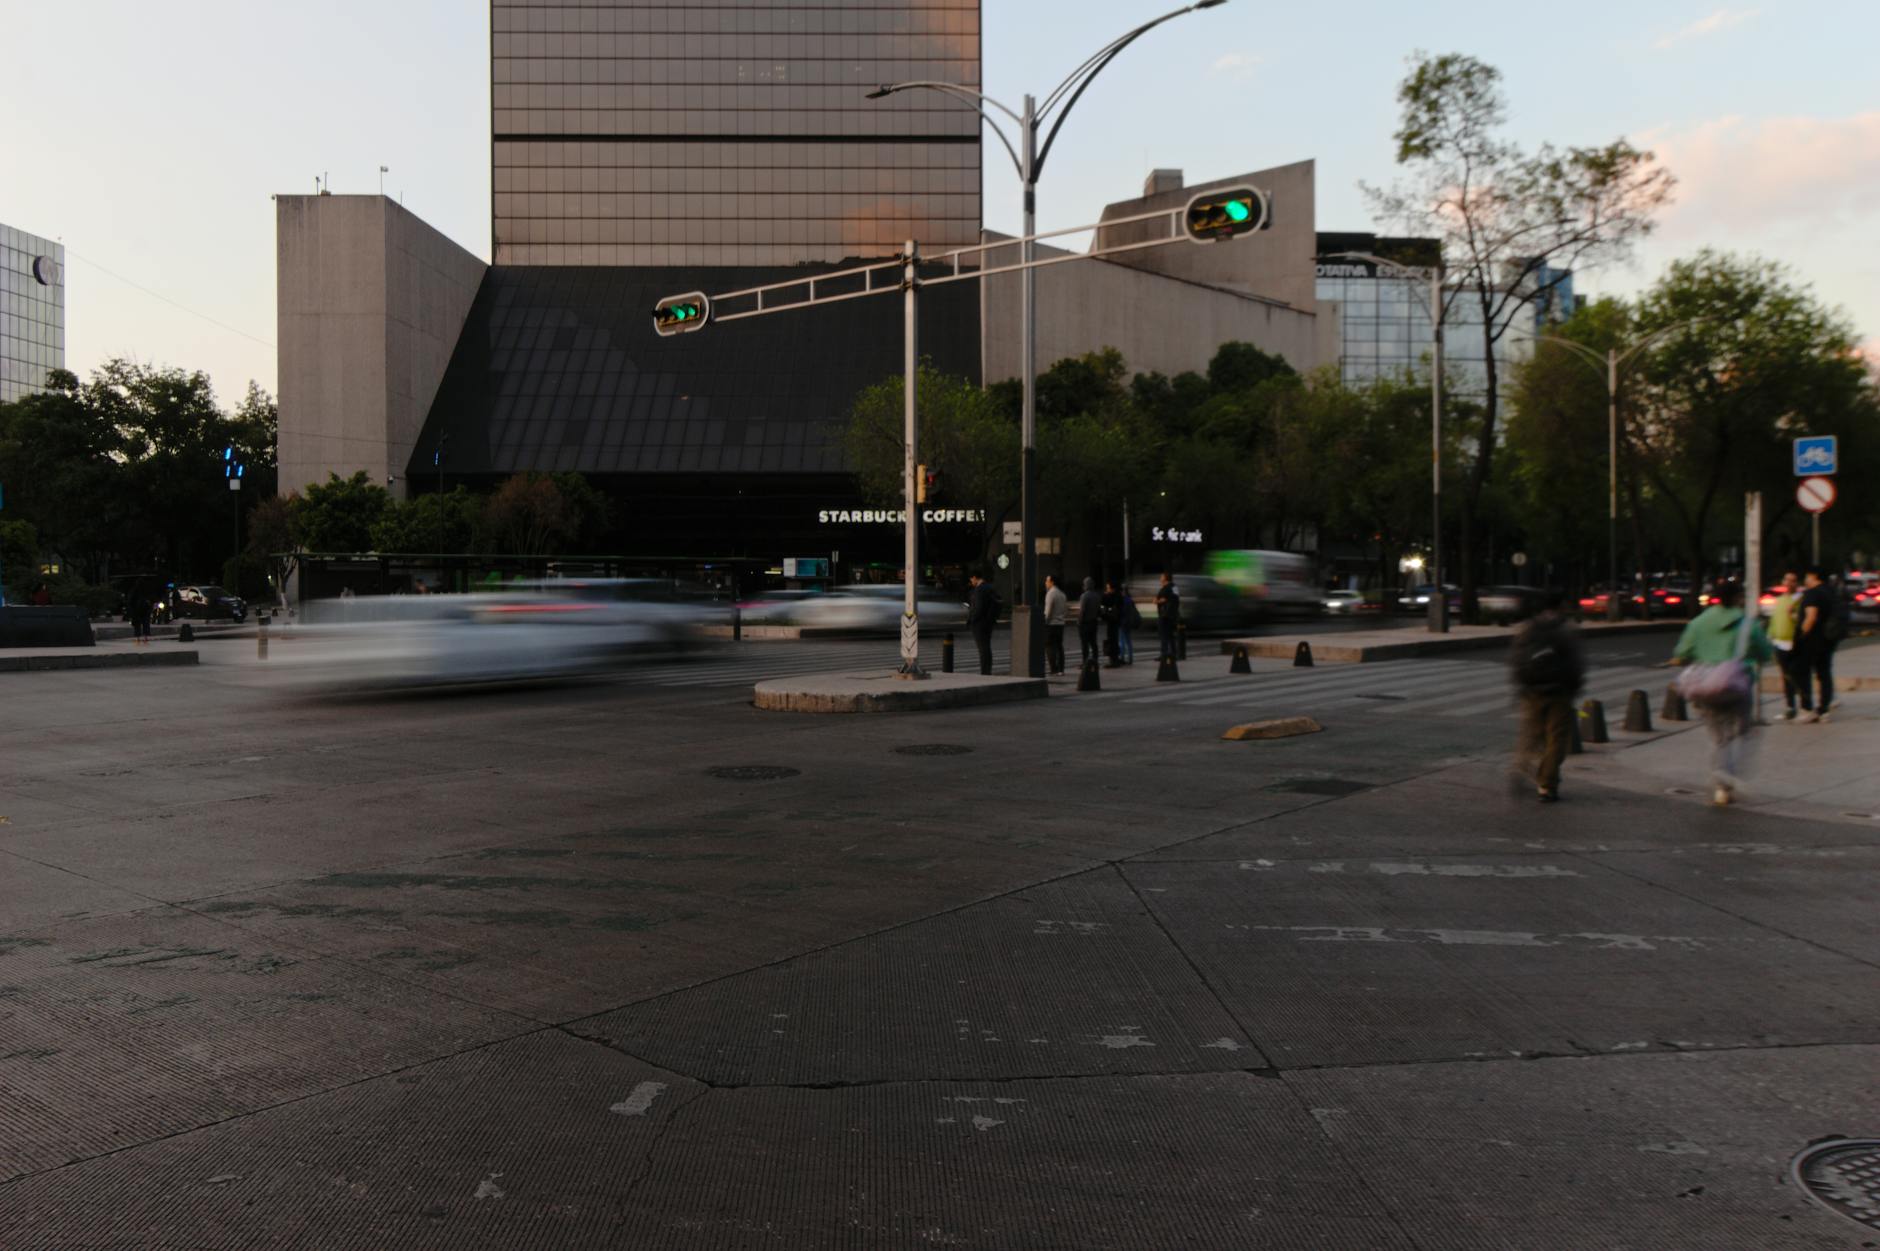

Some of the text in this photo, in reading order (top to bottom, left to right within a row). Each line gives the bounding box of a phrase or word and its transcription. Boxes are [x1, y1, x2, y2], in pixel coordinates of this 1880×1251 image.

[1315, 263, 1369, 277] OTATIVA
[818, 509, 907, 524] STARBUCK
[1151, 526, 1203, 543] Sctiaank
